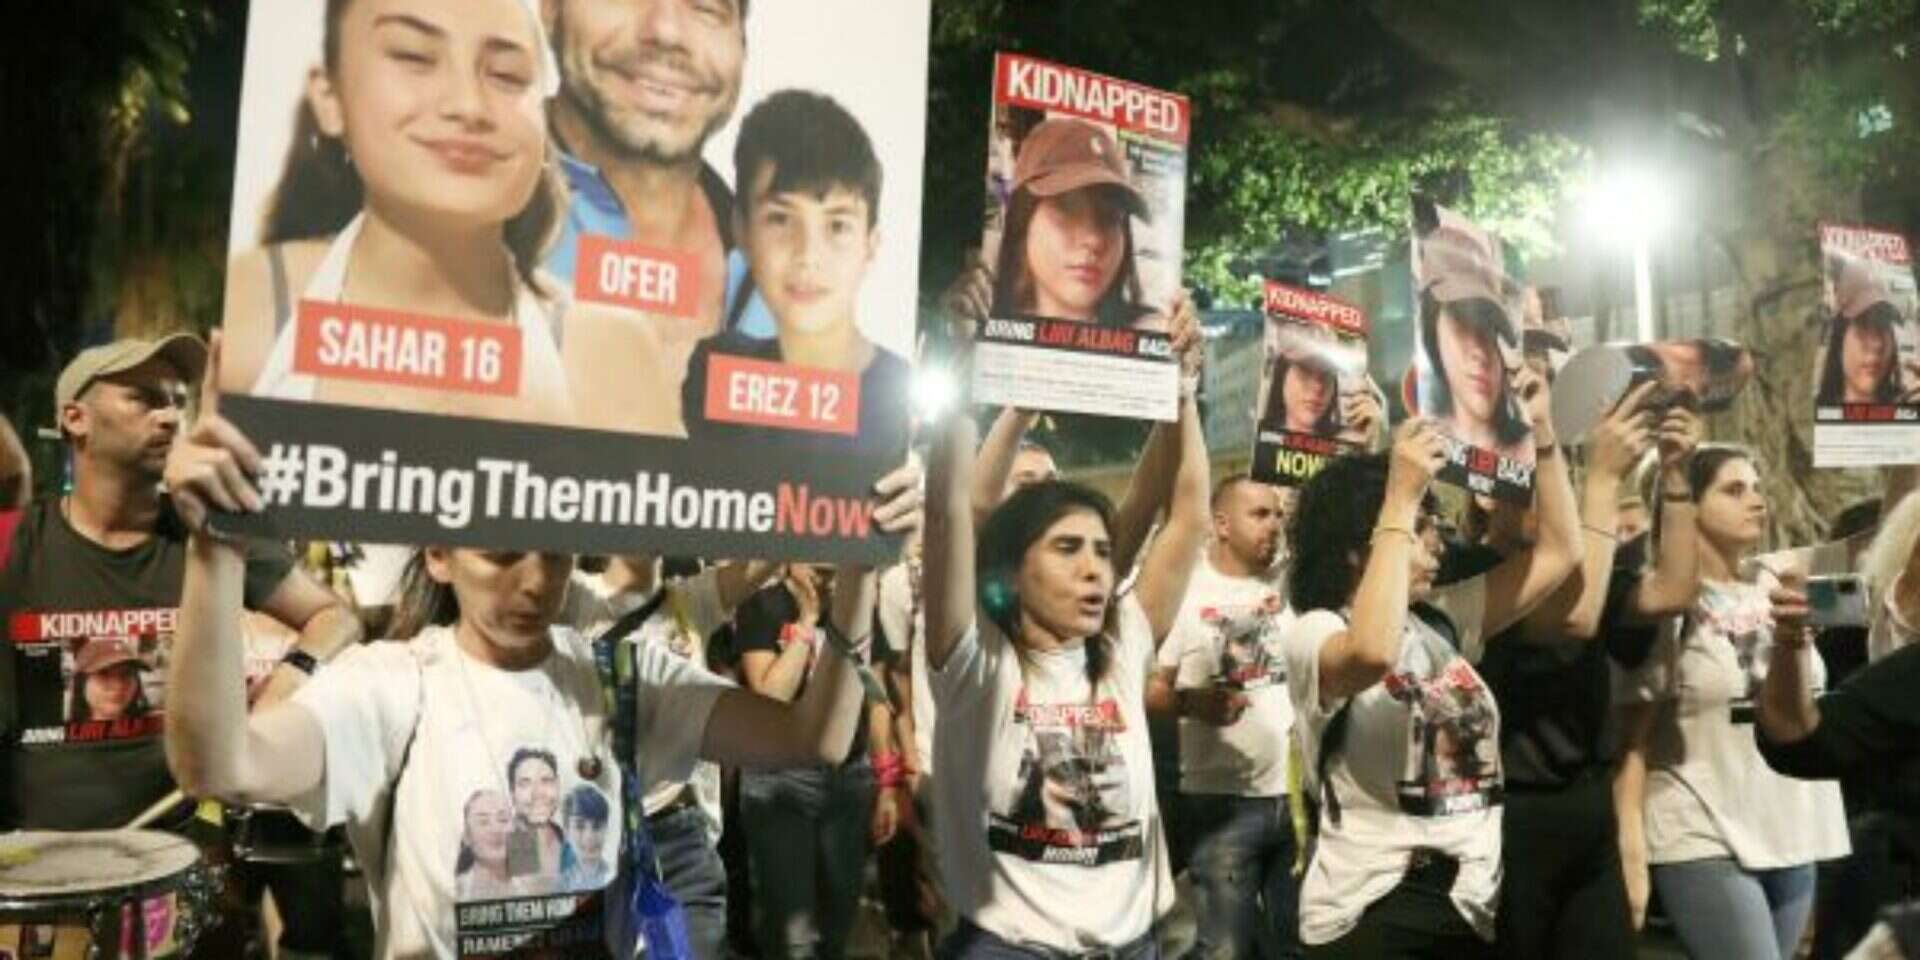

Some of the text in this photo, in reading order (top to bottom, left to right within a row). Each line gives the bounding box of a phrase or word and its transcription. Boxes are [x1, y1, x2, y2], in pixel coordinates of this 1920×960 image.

[1007, 59, 1180, 133] KIDNAPPED
[599, 251, 679, 305] OFER
[985, 319, 1035, 341] BRING
[1268, 286, 1363, 326] KIDNAPPED
[318, 315, 503, 384] SAHAR 16
[728, 370, 841, 421] EREZ 12
[258, 440, 875, 541] #BringThemHomeNow
[460, 903, 503, 929] BRING
[504, 900, 546, 924] THEM
